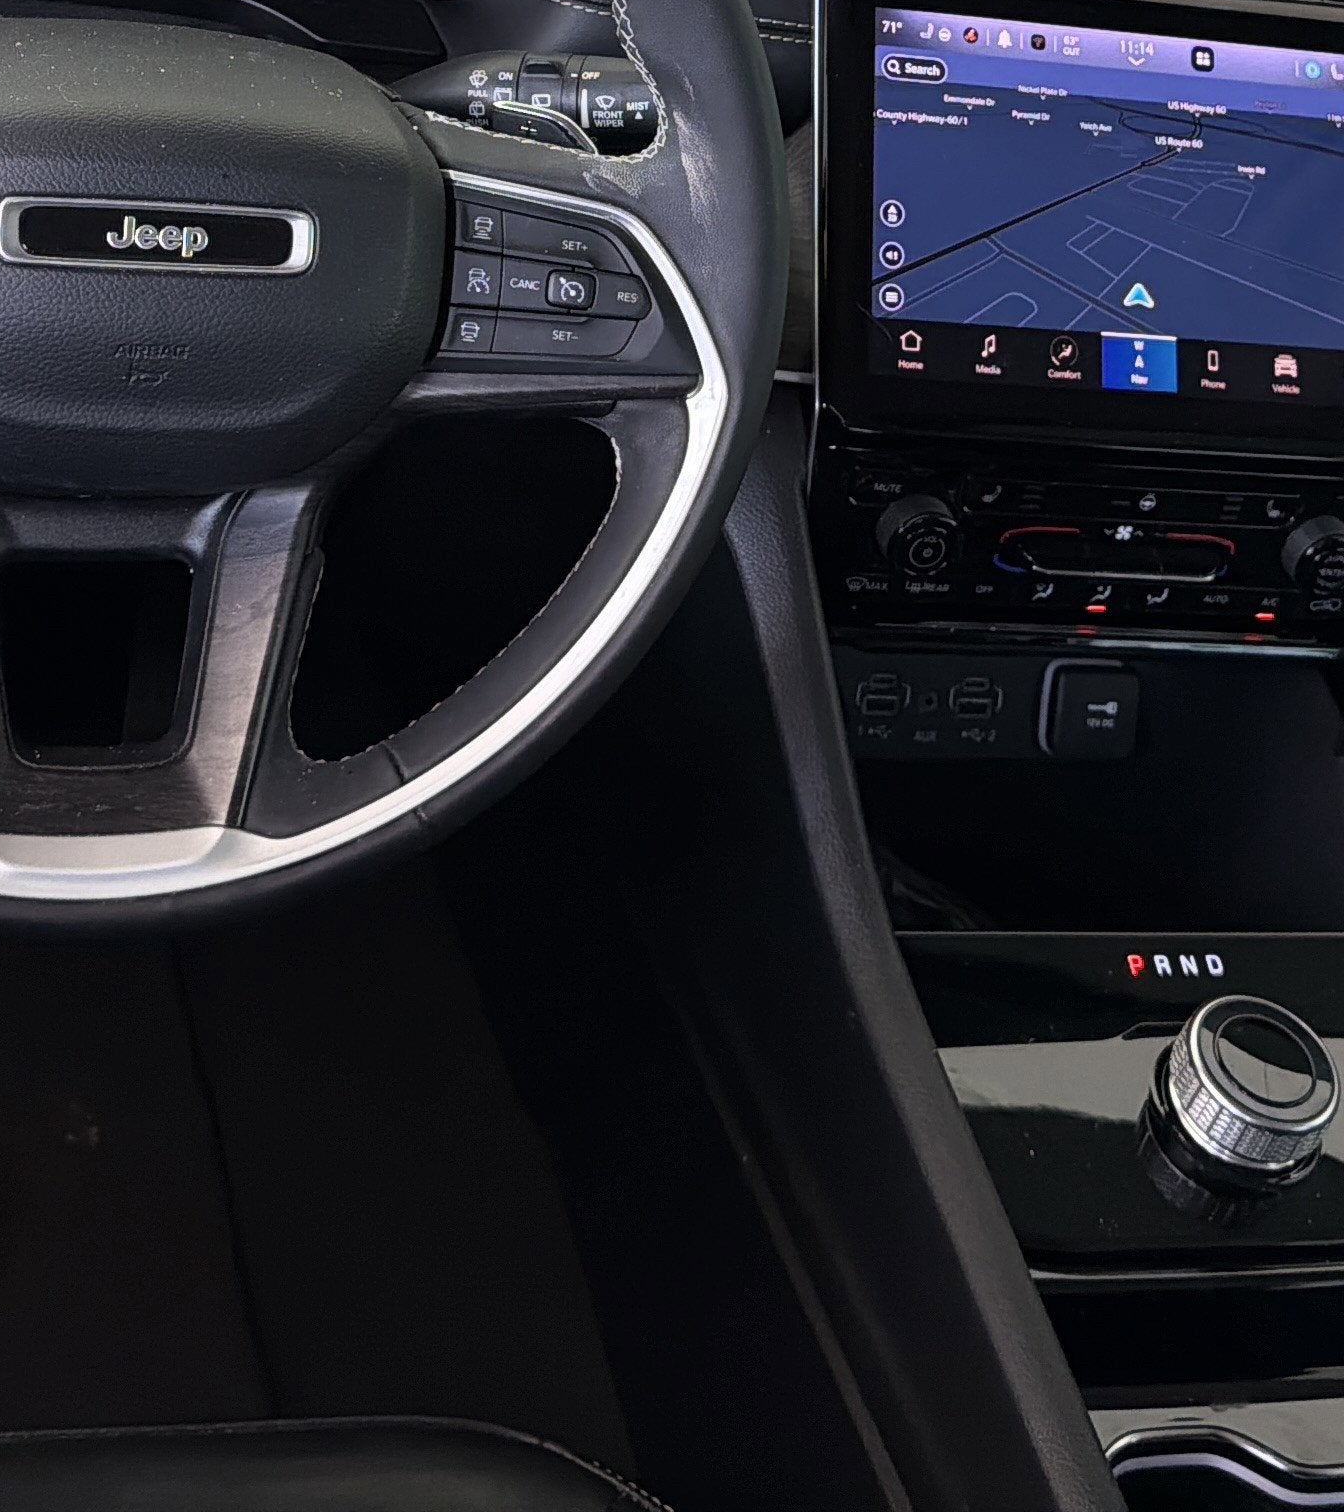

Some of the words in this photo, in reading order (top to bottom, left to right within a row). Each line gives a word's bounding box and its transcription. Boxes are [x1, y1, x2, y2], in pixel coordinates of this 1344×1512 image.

[881, 19, 903, 35] 71°
[1062, 46, 1080, 57] OUT
[1119, 39, 1154, 56] 11:14
[581, 71, 601, 81] OFF
[904, 62, 941, 77] Search
[498, 71, 514, 82] ON
[467, 89, 489, 99] PULL
[626, 100, 650, 111] MIST
[985, 98, 996, 107] Dr
[1167, 100, 1179, 111] US
[1180, 102, 1215, 116] Highway
[1215, 105, 1227, 115] 60
[592, 110, 624, 120] FRONT
[875, 108, 907, 123] County
[1011, 109, 1041, 122] Pyramid
[1041, 112, 1051, 121] Dr
[594, 118, 625, 128] WIPER
[1154, 136, 1167, 146] US
[1168, 137, 1190, 148] Route
[1191, 139, 1204, 149] 60
[106, 215, 209, 259] Jeep
[509, 276, 541, 291] CANC
[617, 290, 638, 304] RES
[897, 357, 925, 372] Home
[974, 363, 1002, 377] Media
[1047, 368, 1082, 382] Comfort
[1200, 378, 1227, 392] Phone
[1271, 383, 1301, 396] Vehicle
[873, 482, 904, 495] MUTE
[866, 580, 889, 592] MAX
[975, 583, 994, 594] OFF
[1202, 594, 1230, 605] AUTO
[1261, 596, 1280, 608] A/C
[912, 729, 938, 743] AUX
[1126, 953, 1145, 978] P
[1153, 954, 1172, 977] R
[1179, 954, 1199, 977] N
[1205, 954, 1224, 977] D
